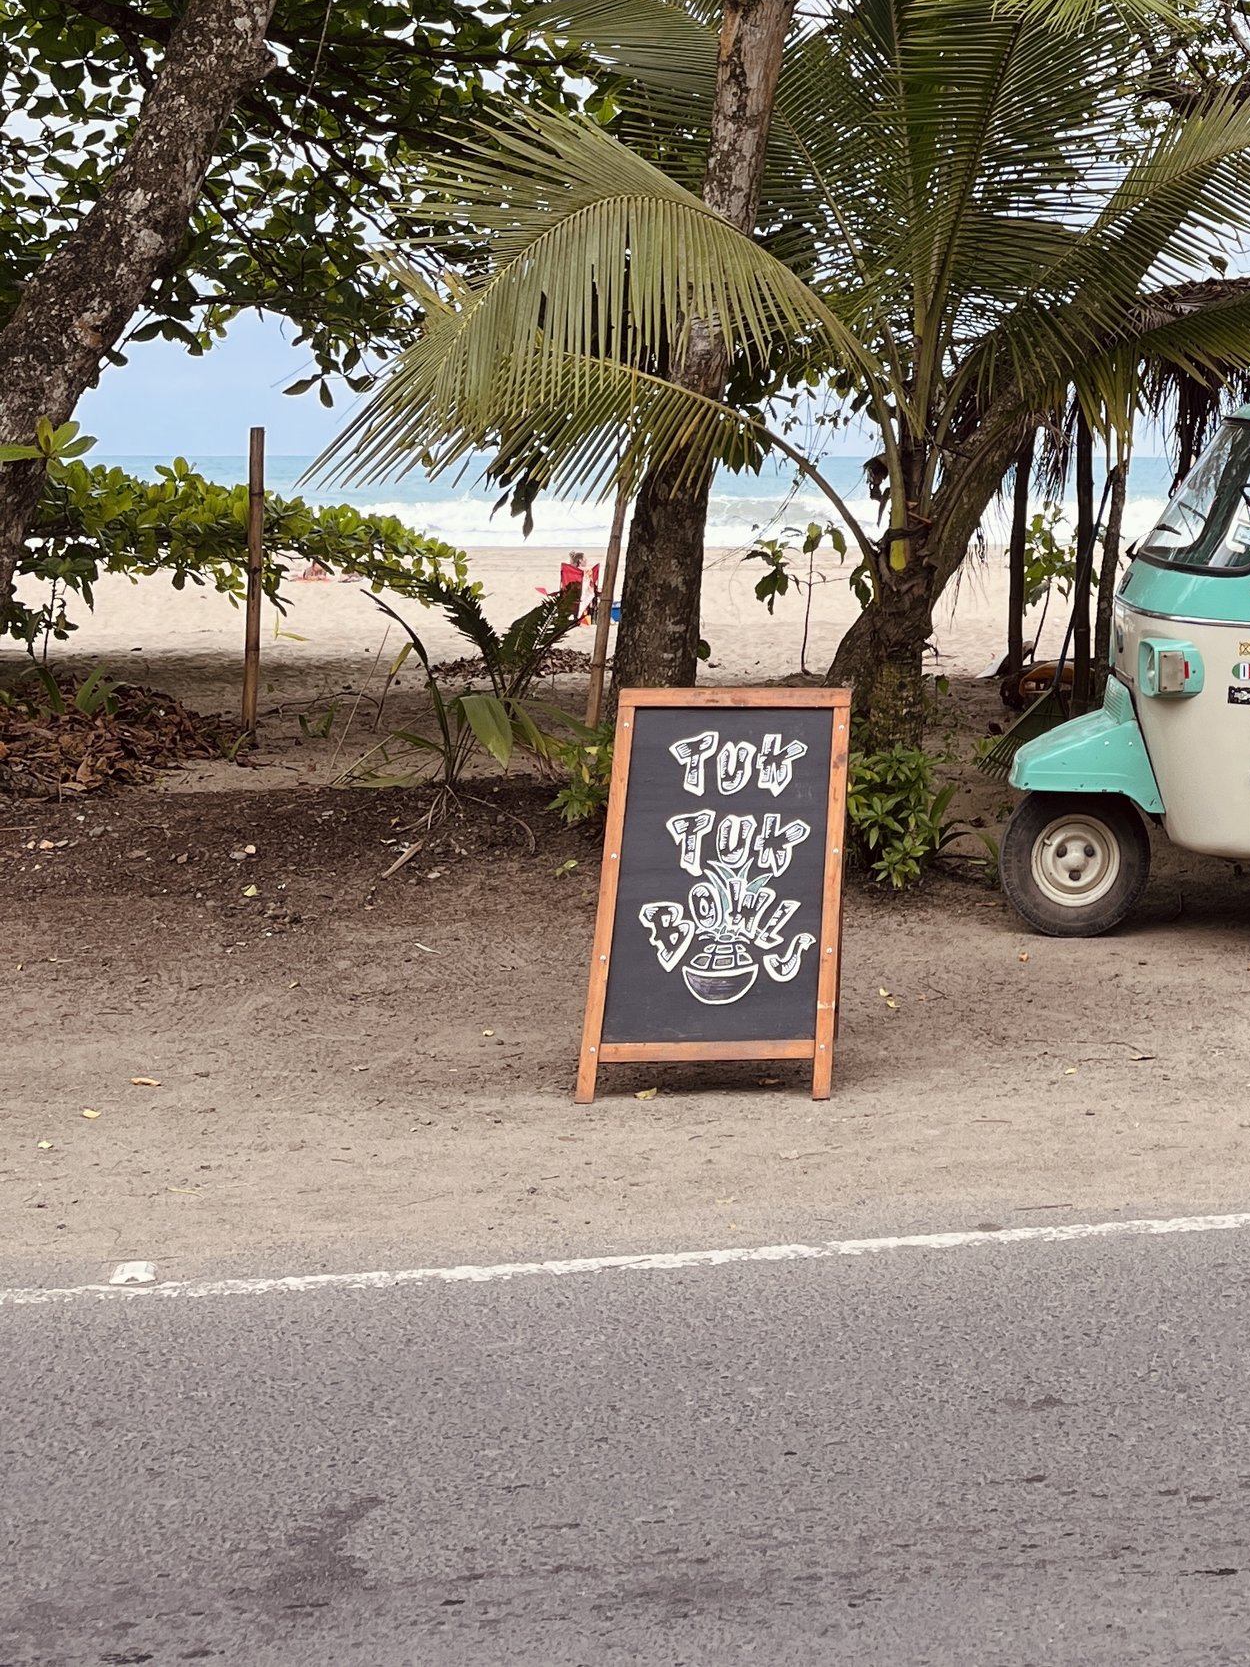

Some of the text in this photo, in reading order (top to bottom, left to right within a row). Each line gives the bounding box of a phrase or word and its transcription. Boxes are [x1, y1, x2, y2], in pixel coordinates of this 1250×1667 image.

[668, 731, 809, 797] TUK
[666, 809, 811, 877] TUK
[638, 877, 816, 983] BOWLS
